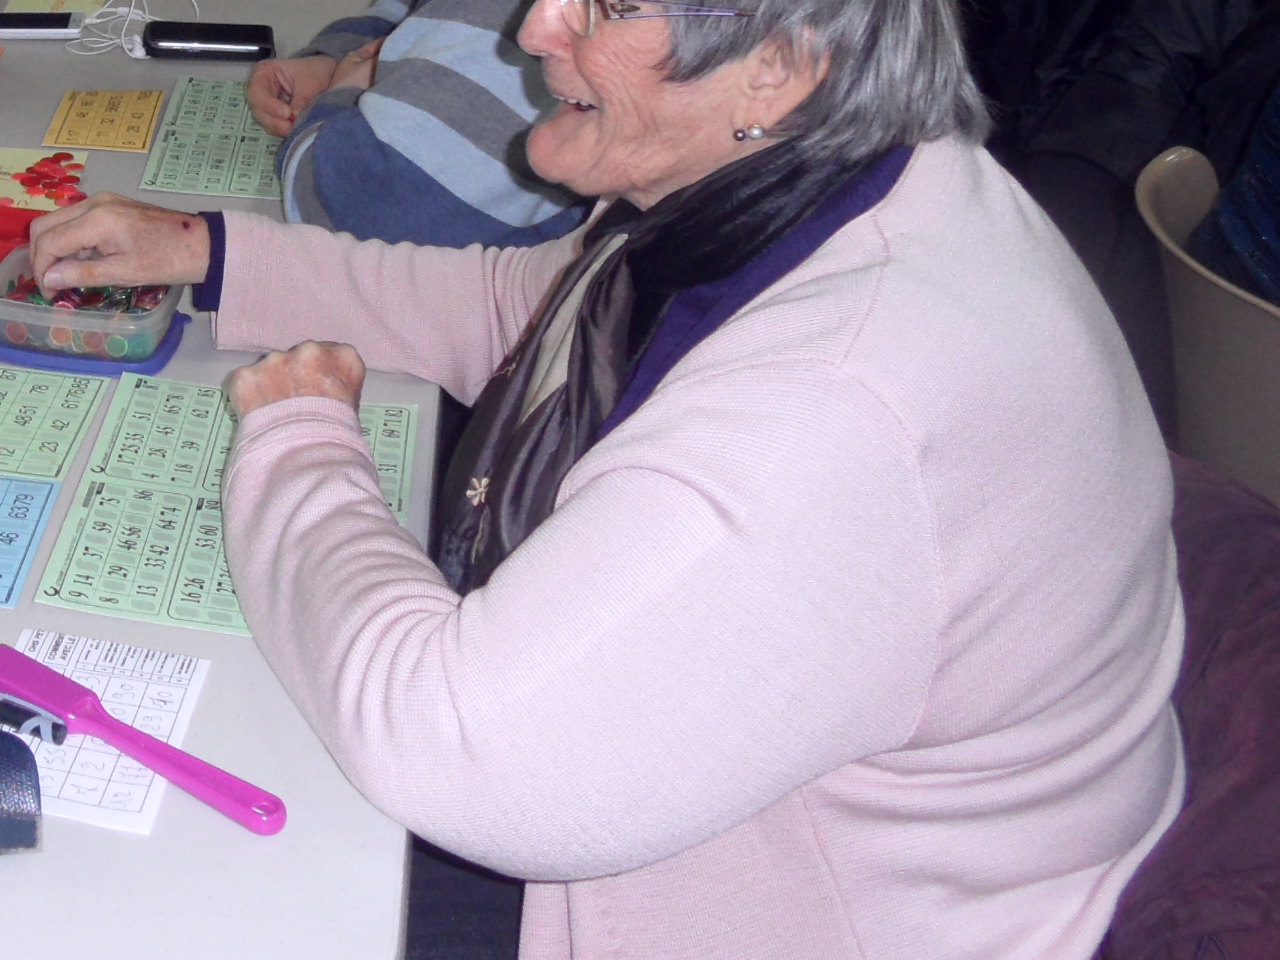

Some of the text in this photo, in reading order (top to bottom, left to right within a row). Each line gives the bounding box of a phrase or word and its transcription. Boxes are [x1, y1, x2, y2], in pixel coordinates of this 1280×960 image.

[29, 384, 49, 395] 78
[38, 441, 59, 453] 23
[51, 419, 70, 432] 42
[13, 493, 35, 506] 79
[8, 505, 30, 519] 63
[198, 524, 219, 537] 60
[68, 497, 120, 599] 9 14 37 59 75
[99, 489, 154, 605] 8 29 46 56 86
[195, 537, 216, 550] 53
[136, 506, 182, 597] 13 33 42 64 74
[184, 576, 206, 591] 26
[180, 590, 201, 605] 16
